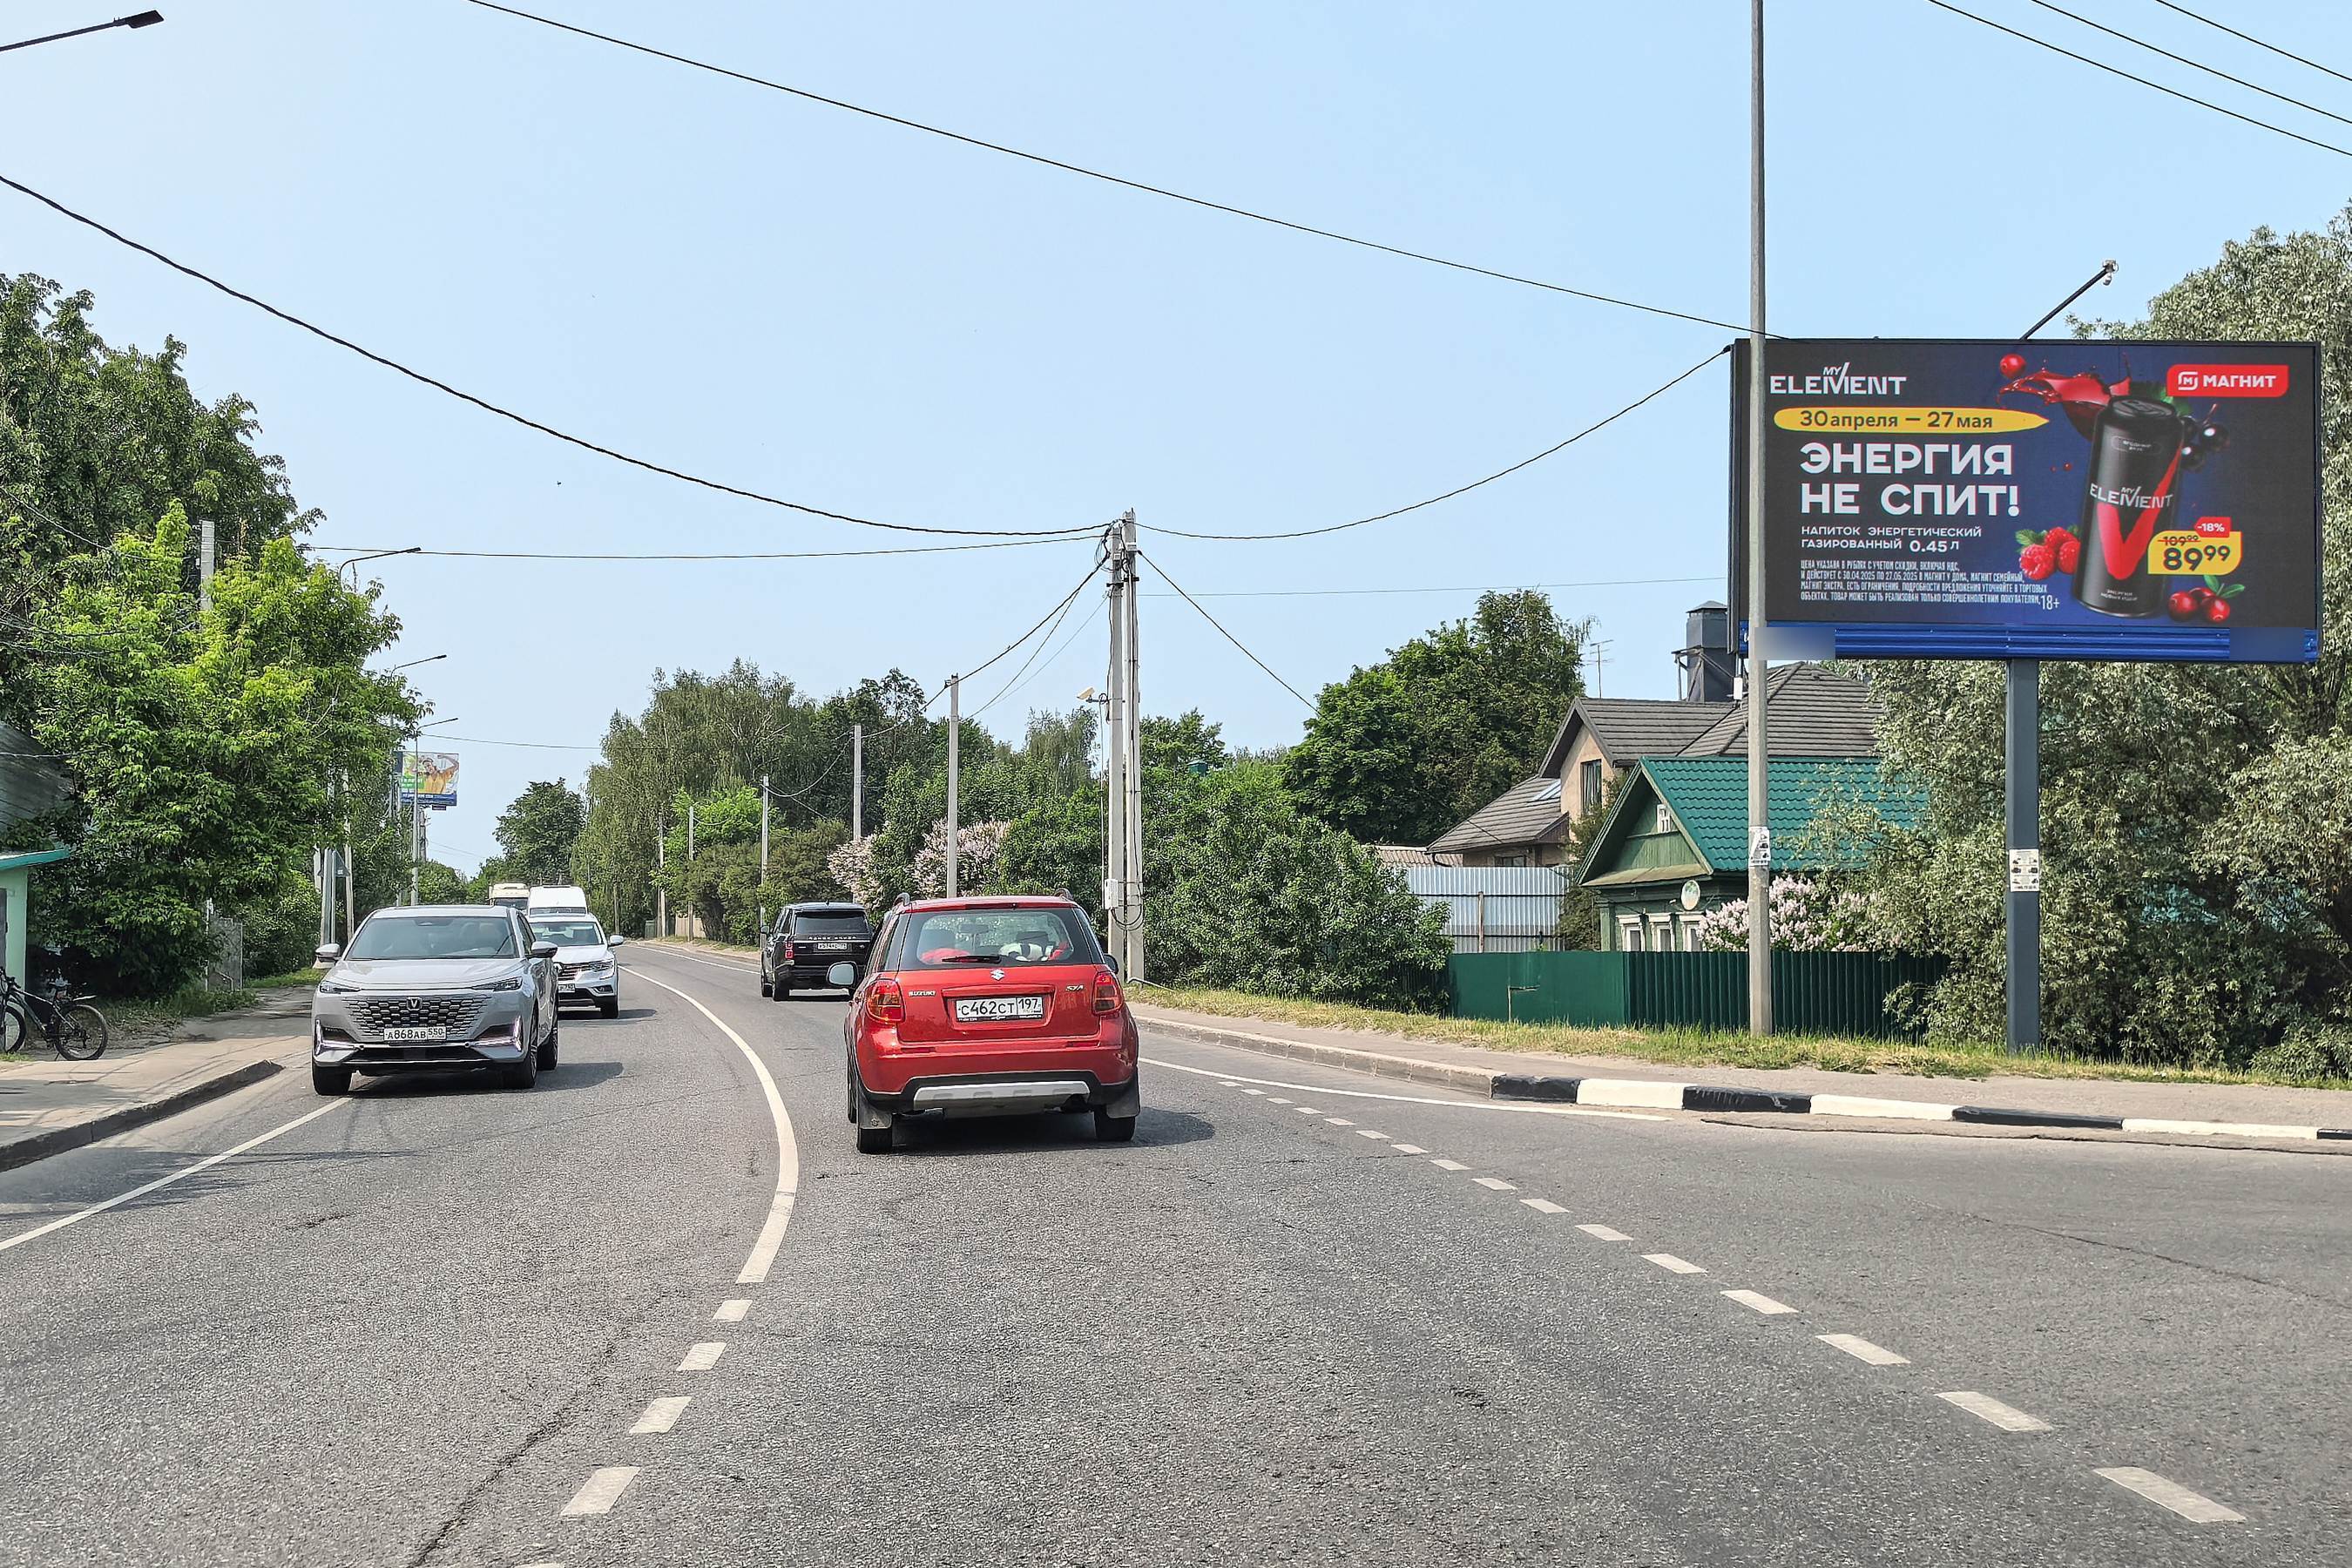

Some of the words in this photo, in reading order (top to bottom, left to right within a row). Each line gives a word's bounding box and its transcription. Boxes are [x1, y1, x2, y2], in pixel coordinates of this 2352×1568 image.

[1822, 367, 1842, 375] MY
[1770, 362, 1907, 395] ELEMENT
[2203, 375, 2276, 388] МАГНИТ
[1830, 416, 1898, 430] апреля
[1928, 411, 1954, 428] 27
[1957, 416, 1992, 428] мая
[1800, 443, 2012, 475] ЭНЕРГИЯ
[1801, 483, 1860, 514] НЕ
[1881, 483, 2020, 517] СПИТ!
[2090, 483, 2173, 509] ELEMENT
[1801, 526, 1861, 536] НАПИТОК
[1868, 525, 1982, 537] ЭНЕРГЕТИЧЕСКИЙ
[2197, 523, 2225, 532] -18%
[1801, 538, 1902, 550] ГАЗИРОВАННЫЙ
[1801, 560, 1815, 570] ЦЕНА
[1816, 560, 1840, 569] УКАЗАНА
[1847, 560, 1866, 570] РУБЛЯХ
[1873, 561, 1893, 570] УЧЕТОМ
[1920, 561, 1945, 571] ВКЛЮЧАЯ
[1806, 569, 1836, 580] ДЕЙСТВУЕТ
[1842, 571, 1876, 580] 30.04.2025
[1876, 571, 1884, 580] ПО
[1885, 571, 1917, 580] 27.05.2025
[1924, 572, 1945, 581] МАГНИТ
[1970, 573, 1992, 582] МАГНИТ
[1801, 581, 1821, 590] МАГНИТ
[1847, 582, 1860, 591] ЕСТЬ
[1902, 582, 1940, 592] ПОДРОБНОСТИ
[1942, 583, 1981, 593] ПРЕДЛОЖЕНИЯ
[1982, 582, 2012, 592] УТОЧНЯЙТЕ
[2019, 584, 2047, 593] ТОРГОВЫХ
[1830, 592, 1847, 601] ТОВАР
[1848, 592, 1868, 601] МОЖЕТ
[1869, 592, 1883, 601] БЫТЬ
[1885, 592, 1919, 602] РЕАЛИЗОВАН
[1921, 593, 1941, 602] ТОЛЬКО
[1942, 593, 1999, 603] СОВЕРШЕННОЛЕТНИМ
[2040, 595, 2059, 610] 18+
[1018, 998, 1039, 1010] 197
